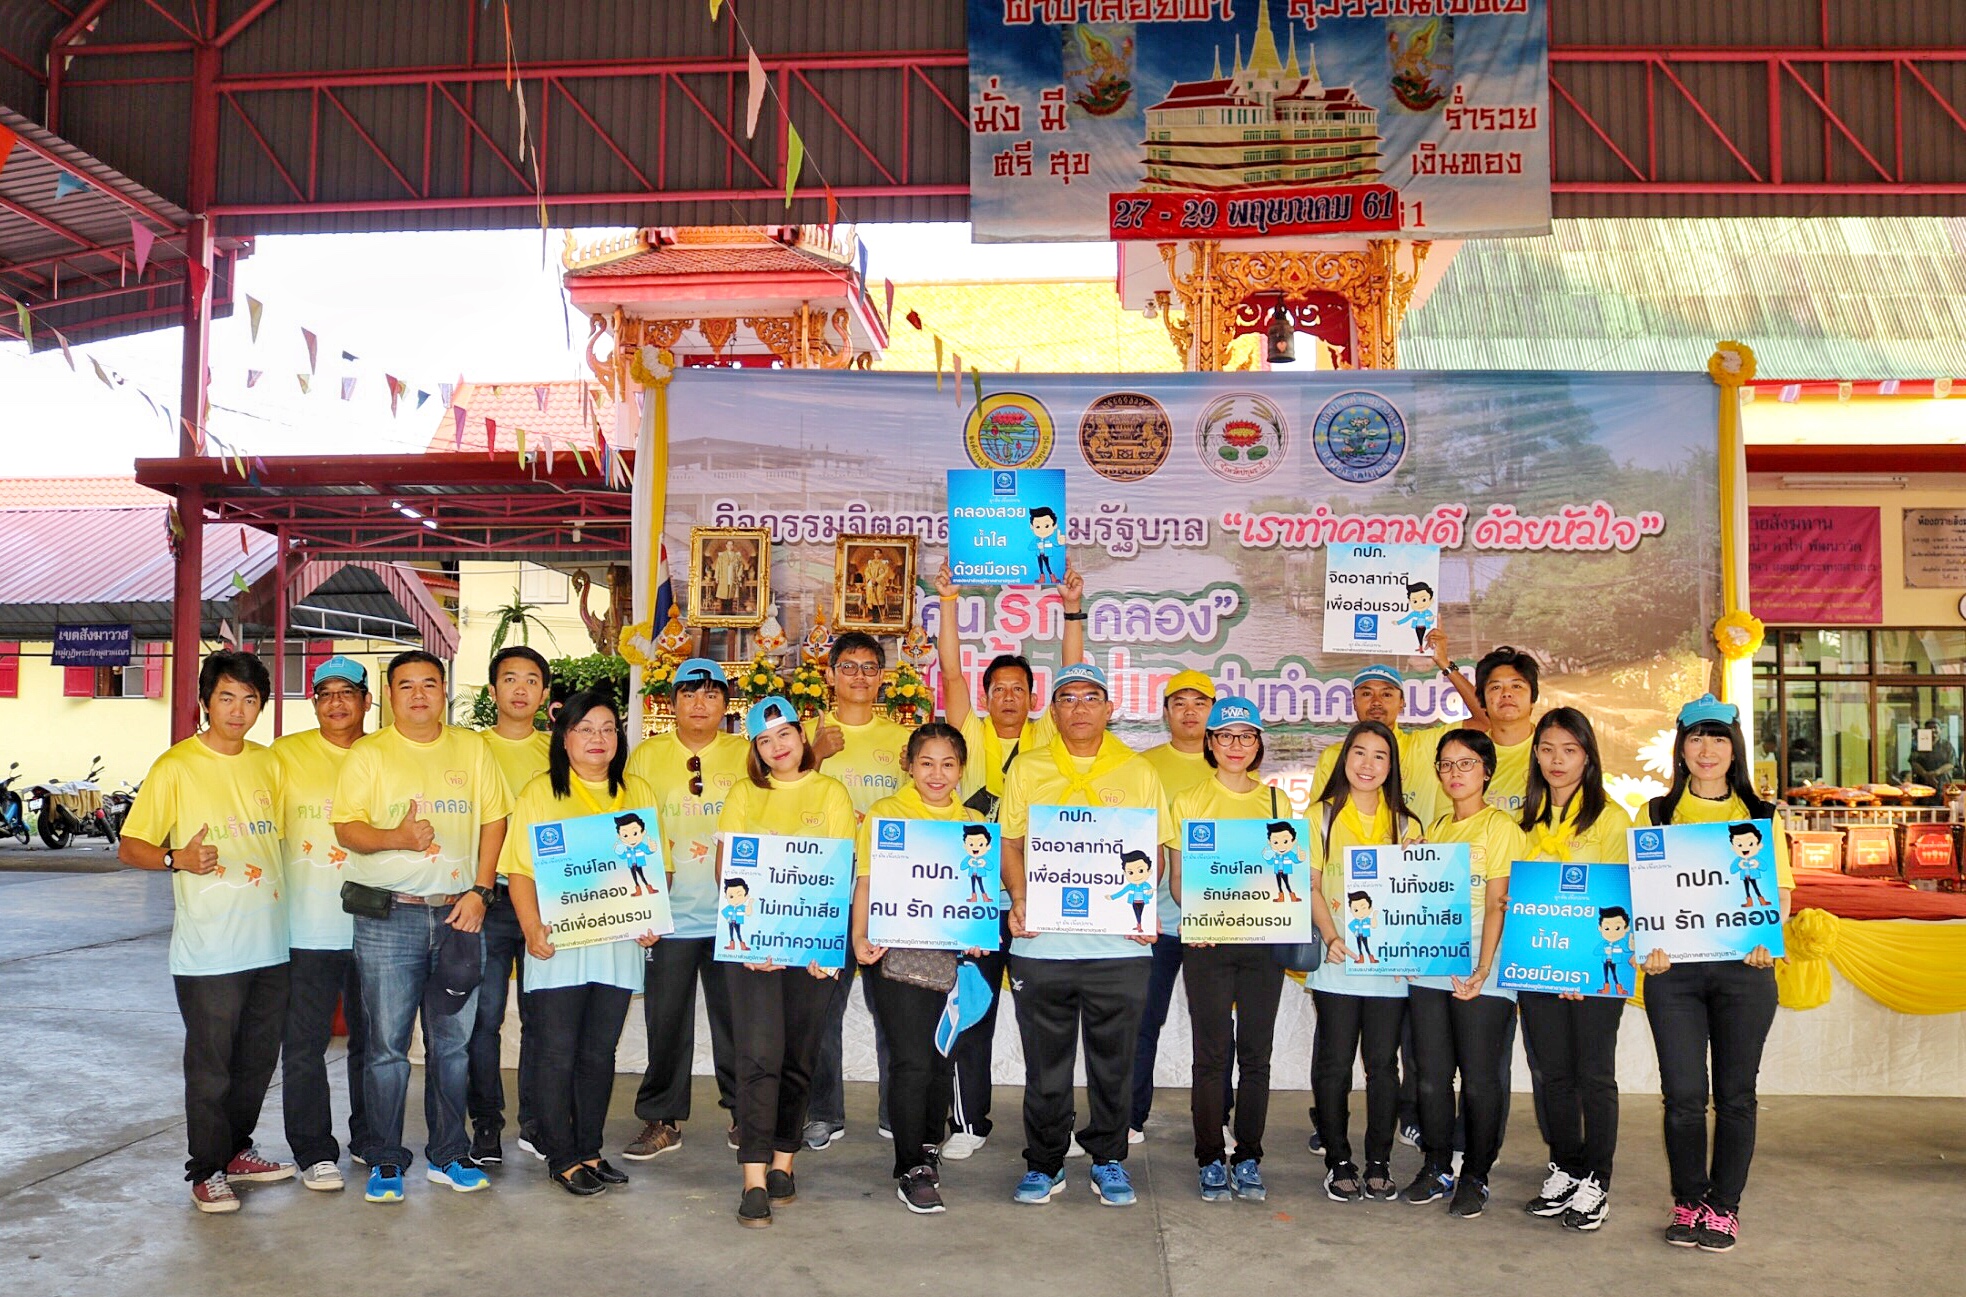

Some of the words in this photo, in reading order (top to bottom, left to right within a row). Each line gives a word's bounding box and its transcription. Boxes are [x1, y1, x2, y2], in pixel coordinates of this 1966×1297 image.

[974, 79, 1021, 132] มั่ง
[1040, 88, 1067, 131] มี
[1446, 86, 1537, 130] ร่ำรวย
[994, 141, 1032, 176] ศรี
[1050, 150, 1091, 185] สุข
[1411, 142, 1523, 175] เงินทอง
[1113, 199, 1151, 228] 27
[1181, 198, 1218, 228] 29
[1228, 193, 1353, 233] พฤษภาคม
[1362, 190, 1394, 219] 61
[953, 506, 1026, 518] คลองสวย
[1068, 503, 1204, 552] มรัฐบาล
[973, 529, 1007, 547] น้ำใส
[1353, 546, 1386, 558] กปภ.
[953, 561, 1027, 576] ด้วยมือเรา
[1328, 570, 1410, 586] จิตอาสาทำดี
[1326, 594, 1410, 613] เพื่อส่วนรวม
[1059, 808, 1097, 823] กปภ.
[785, 839, 823, 855] กปภ.
[1031, 837, 1124, 855] จิตอาสาทำดี
[1403, 847, 1441, 862] กปภ.
[563, 858, 617, 878] รักษ์โลก
[768, 866, 835, 887] ไม่ทิ้งขยะ
[912, 863, 959, 880] กปภ.
[1029, 864, 1125, 886] เพื่อส่วนรวม
[1210, 859, 1263, 875] รักษ์โลก
[1389, 874, 1455, 894] ไม่ทิ้งขยะ
[1676, 869, 1730, 888] กปภ.
[560, 885, 629, 905] รักษ์คลอง
[1203, 886, 1270, 901] รักษ์คลอง
[758, 897, 840, 919] ไม่เทน้ำเสีย
[870, 900, 897, 917] คน
[906, 898, 933, 918] รัก
[942, 903, 999, 921] คลอง
[1383, 906, 1463, 926] ไม่เทน้ำเสีย
[1513, 901, 1595, 918] คลองสวย
[549, 907, 653, 935] ำดีเพื่อส่วนรวม
[1182, 910, 1292, 928] ทำดีเพื่อส่วนรวม
[1634, 913, 1665, 932] คน
[1675, 908, 1705, 930] รัก
[1715, 908, 1780, 928] คลอง
[750, 930, 845, 952] ทุ่มทำความดี
[1531, 929, 1569, 950] น้ำใส
[1378, 941, 1470, 963] ทุ่มทำความดี
[1504, 963, 1590, 984] ด้วยมือเรา
